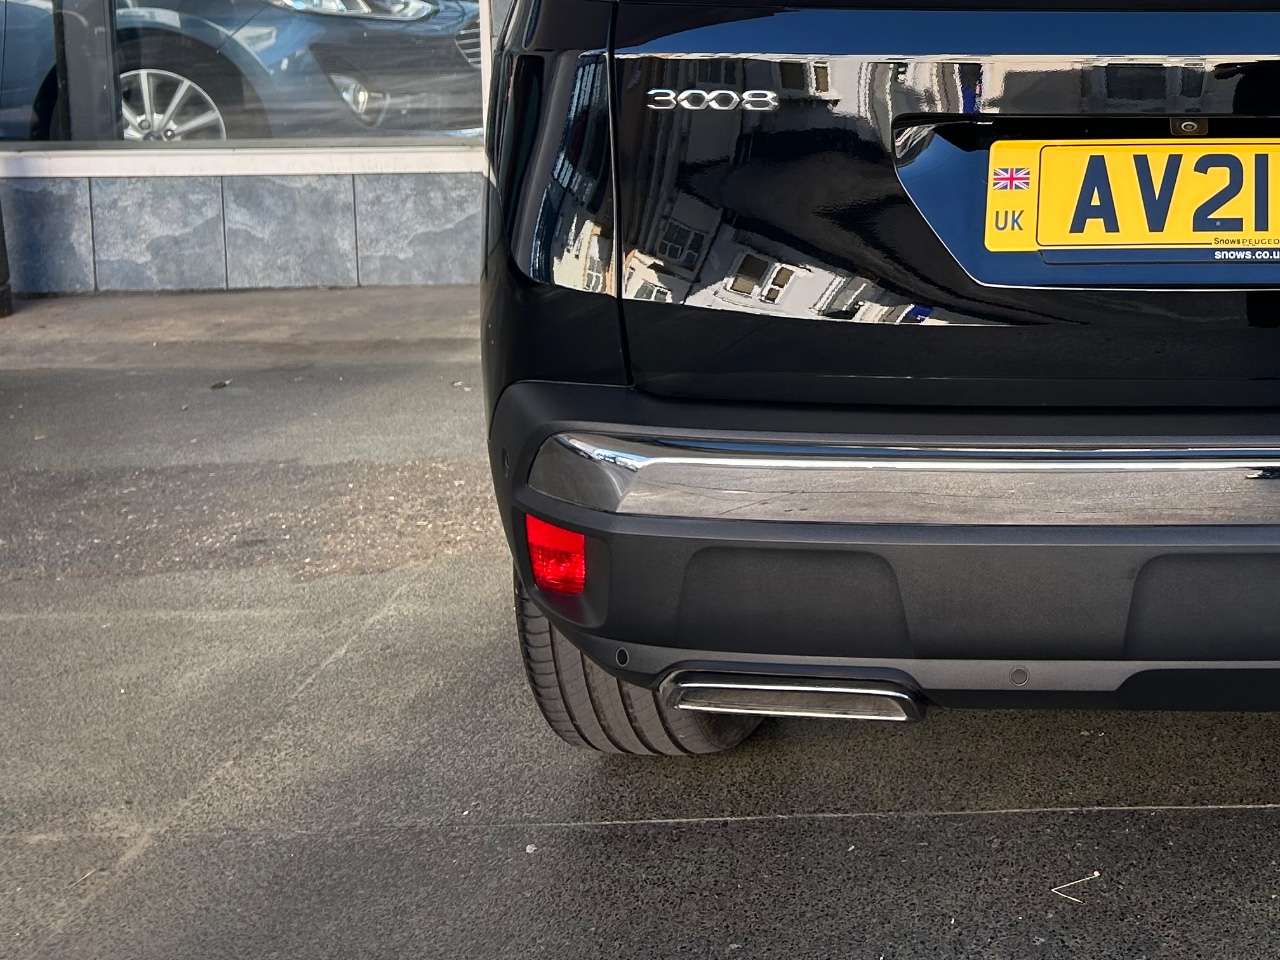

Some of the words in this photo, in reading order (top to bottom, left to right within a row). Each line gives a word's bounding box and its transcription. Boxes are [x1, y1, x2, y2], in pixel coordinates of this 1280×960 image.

[647, 89, 780, 111] 3008
[1069, 153, 1269, 234] AV21
[994, 209, 1025, 231] UK
